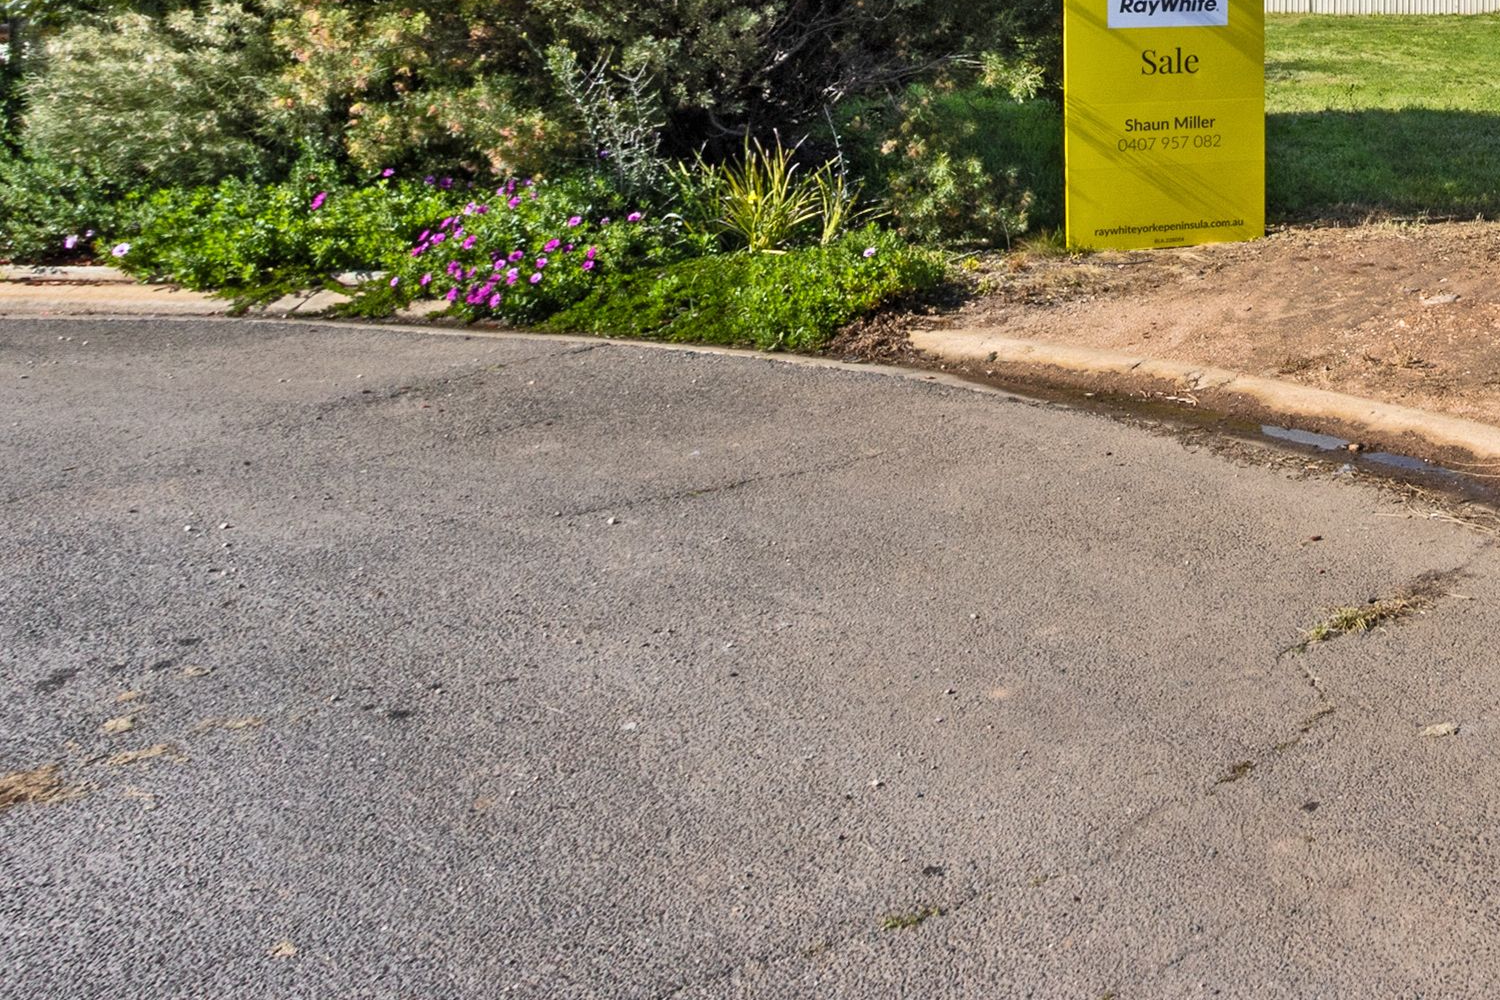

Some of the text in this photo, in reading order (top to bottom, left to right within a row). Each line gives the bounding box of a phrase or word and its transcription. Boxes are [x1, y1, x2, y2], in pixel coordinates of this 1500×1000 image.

[1141, 46, 1199, 75] Sale
[1125, 115, 1216, 132] Shaun Miller
[1117, 134, 1222, 152] 0407 957 082
[1095, 218, 1244, 236] raywhiteyorkepeninsula.com.au
